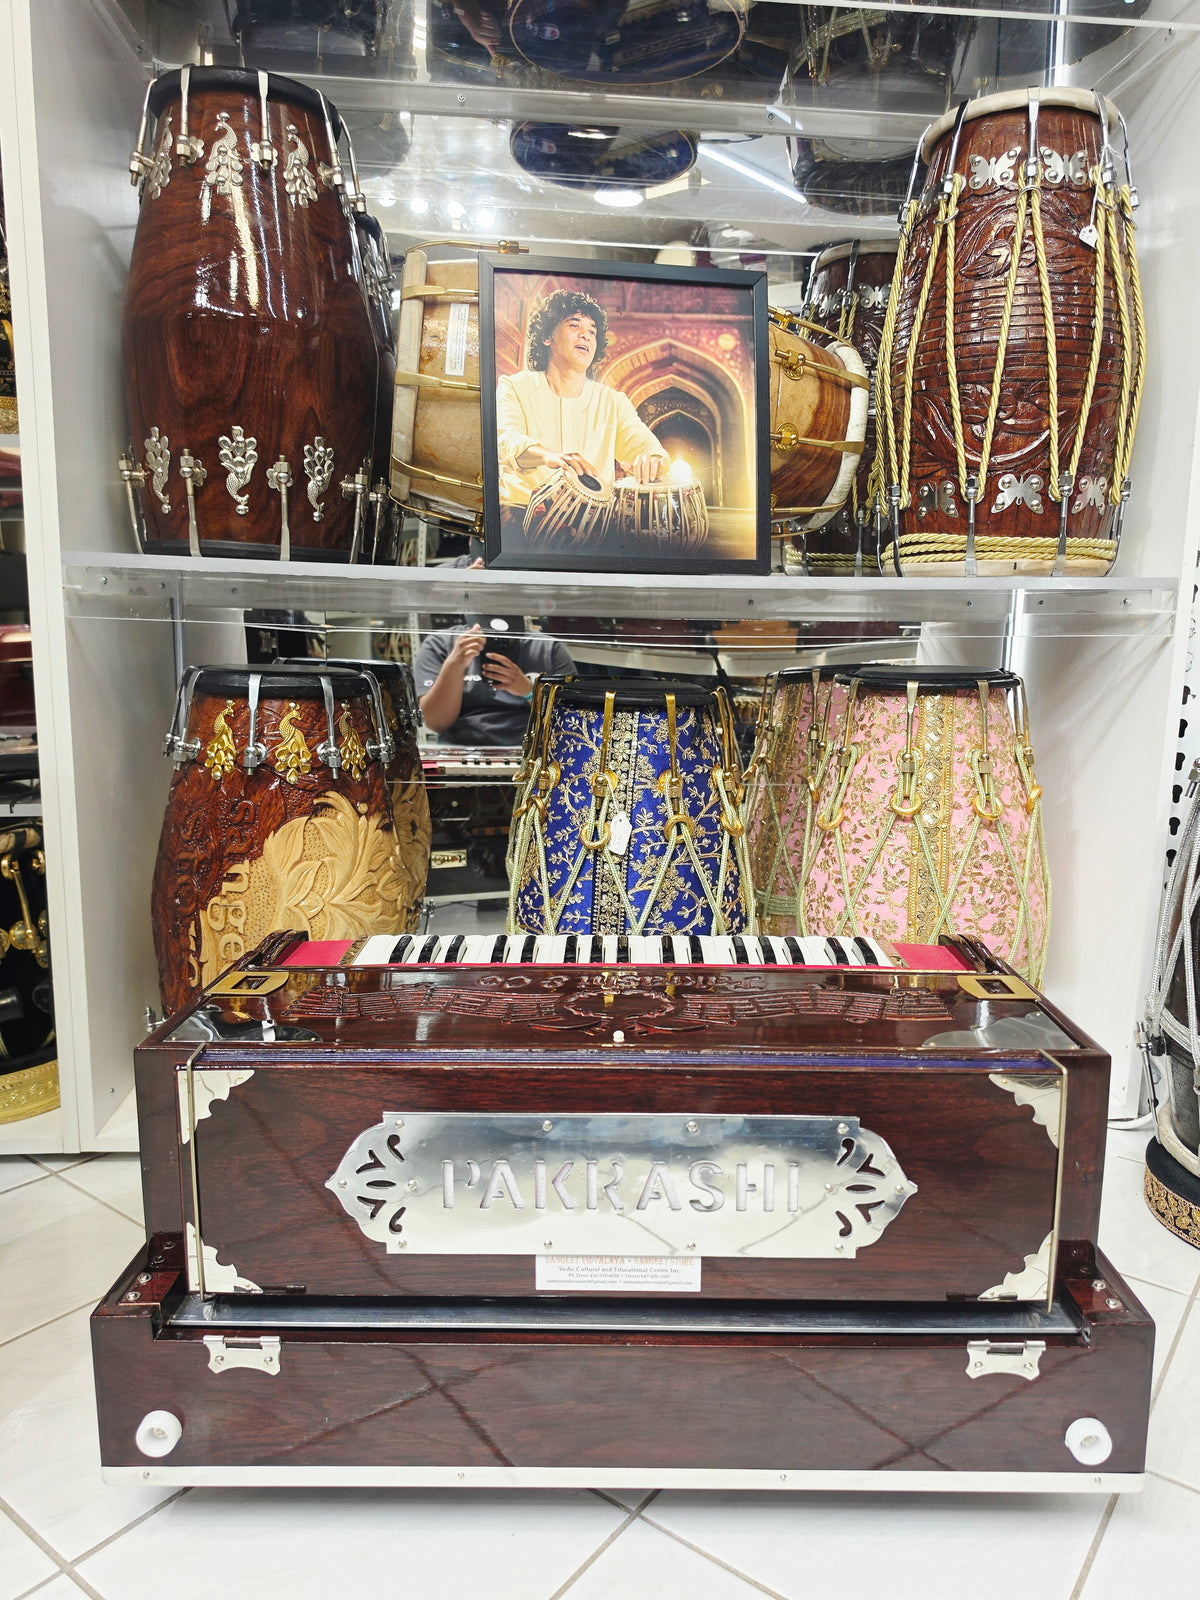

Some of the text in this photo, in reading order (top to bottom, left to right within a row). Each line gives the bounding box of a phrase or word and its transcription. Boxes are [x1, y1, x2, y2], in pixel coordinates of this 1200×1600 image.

[442, 1159, 799, 1213] PAKRASHI
[545, 1256, 694, 1266] SANGEET VIDYALAYA SANGEET STORE
